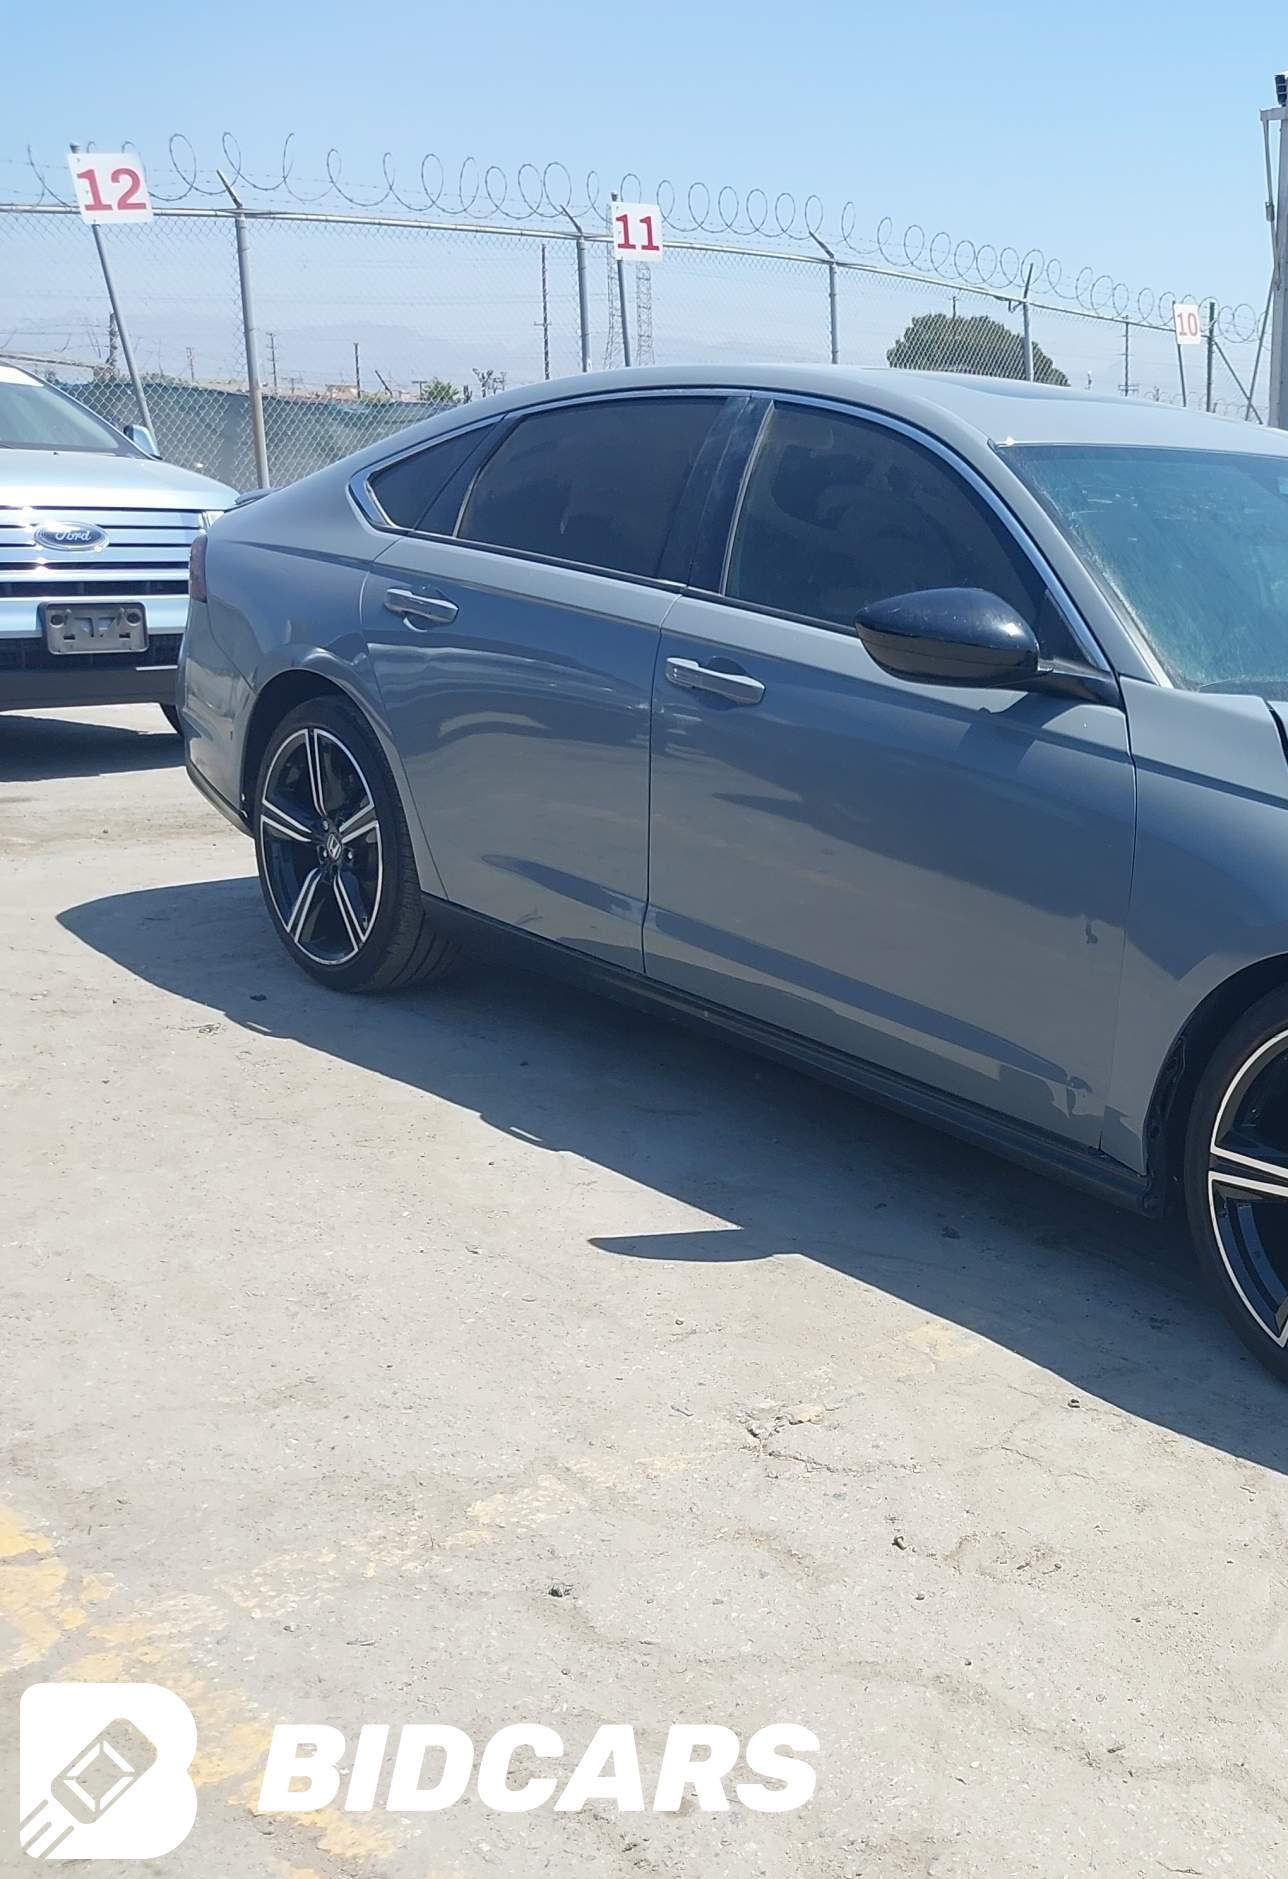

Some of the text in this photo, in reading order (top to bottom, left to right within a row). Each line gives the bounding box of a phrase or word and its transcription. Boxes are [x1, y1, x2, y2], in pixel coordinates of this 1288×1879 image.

[76, 167, 147, 211] 12
[615, 213, 660, 251] 11
[1177, 312, 1198, 337] 10
